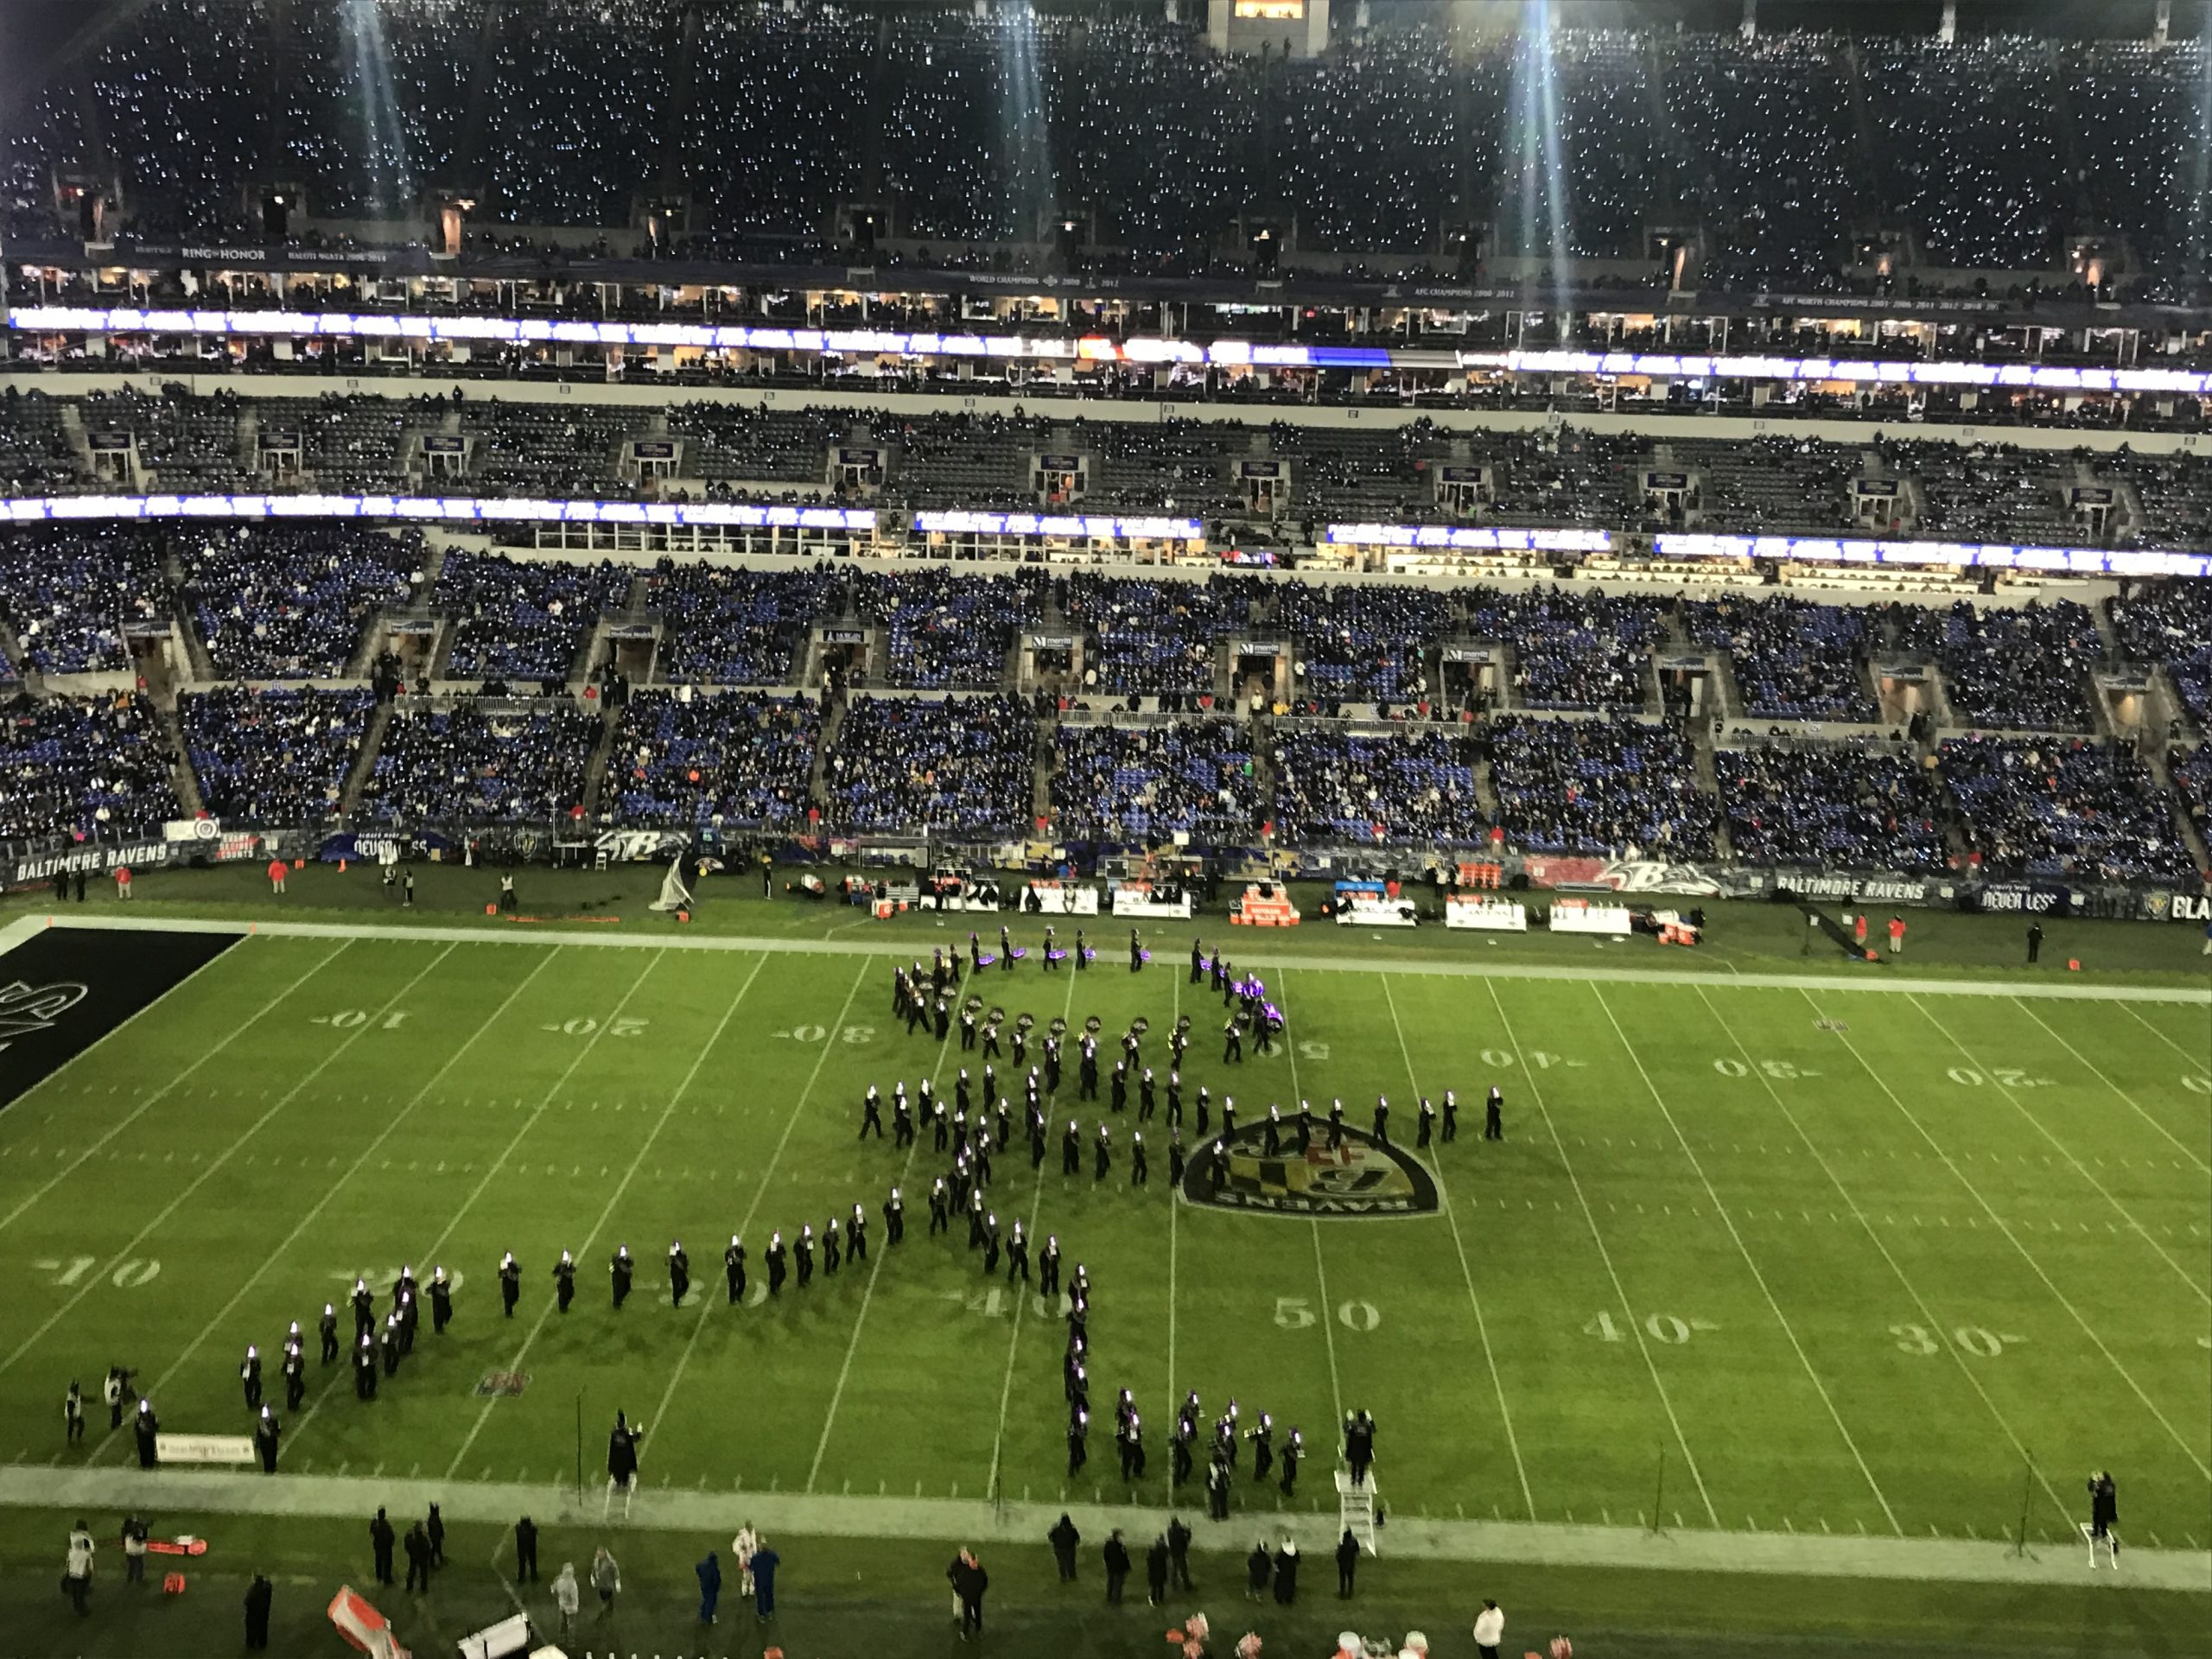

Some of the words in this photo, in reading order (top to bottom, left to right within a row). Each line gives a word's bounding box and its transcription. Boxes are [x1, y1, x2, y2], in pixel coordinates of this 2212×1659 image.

[181, 247, 213, 258] RING
[220, 250, 265, 260] HONOR
[996, 276, 1039, 285] CHAMPIONS
[17, 851, 102, 882] BALTIMORE
[106, 843, 167, 867] RAVENS
[1777, 875, 1861, 896] BALTIMORE
[1865, 880, 1925, 899] RAVENS
[52, 1255, 162, 1287] 10
[1274, 1297, 1381, 1332] 50
[1581, 1311, 1690, 1344] 40
[1888, 1324, 2002, 1357] 30
